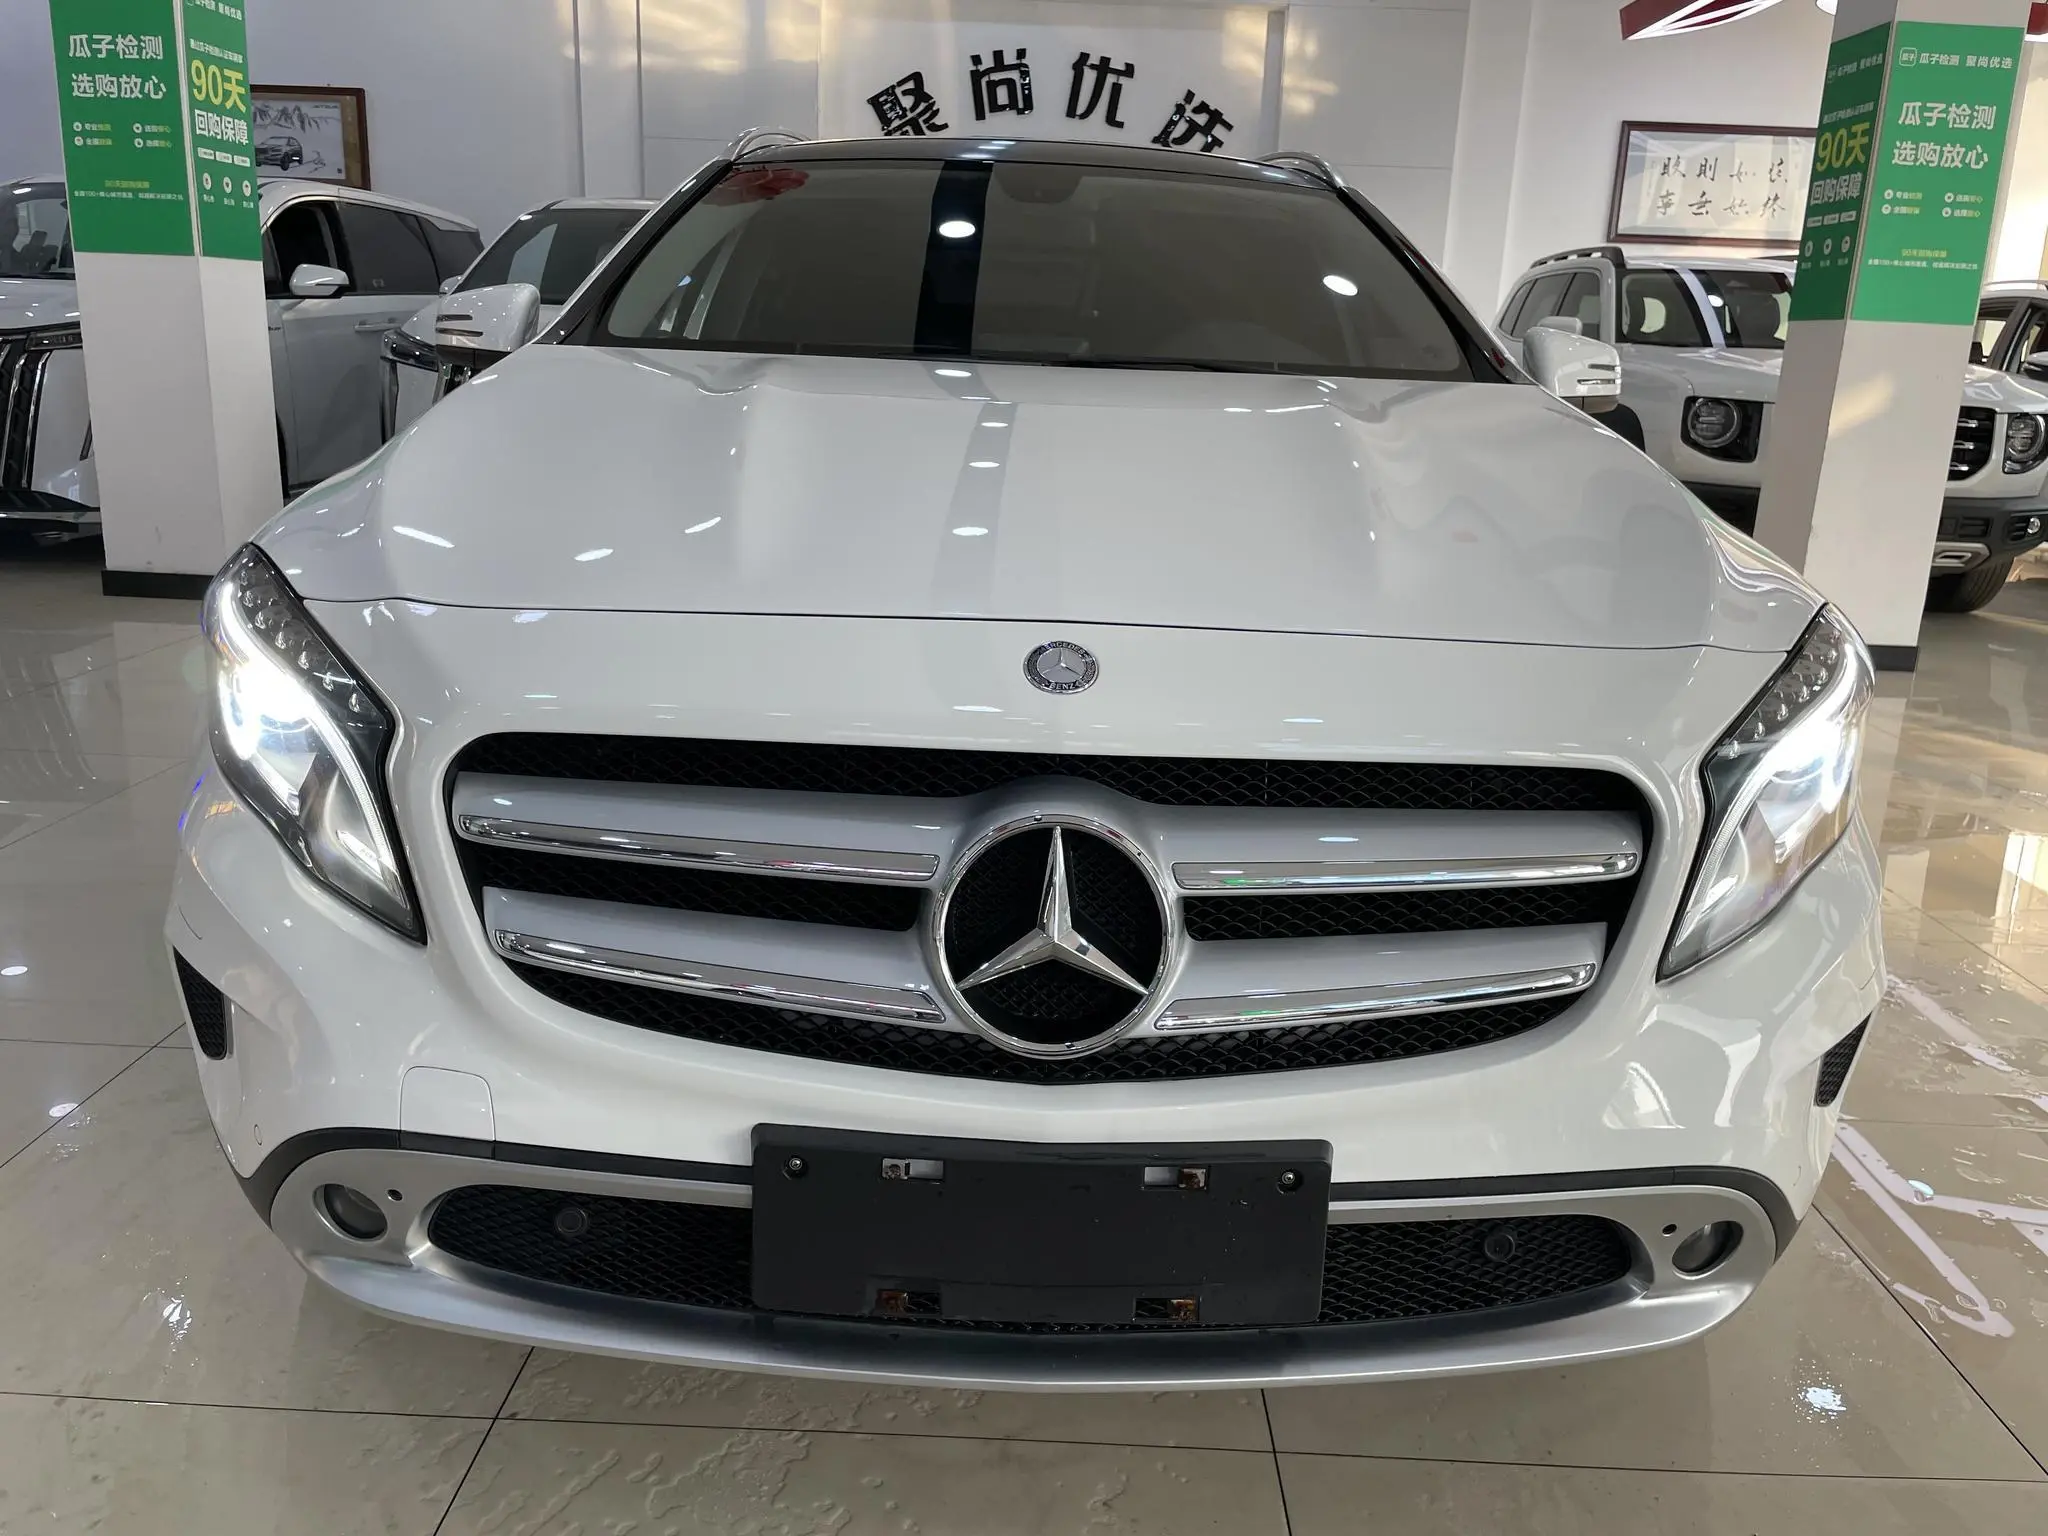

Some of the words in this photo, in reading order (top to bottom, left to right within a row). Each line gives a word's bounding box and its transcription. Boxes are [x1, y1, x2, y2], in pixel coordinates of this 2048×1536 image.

[68, 33, 164, 60] 瓜子检测
[1919, 52, 1960, 66] 瓜子检测
[1965, 54, 2013, 69] 聚尚优选
[71, 72, 167, 100] 选购放心
[191, 58, 247, 115] 90天
[866, 47, 1235, 153] 聚尚优选
[194, 108, 250, 146] 回购保障
[1897, 100, 1997, 132] 瓜子检测
[1815, 120, 1871, 173] 90天
[1891, 140, 1990, 170] 选购放心
[1810, 171, 1864, 206] 回购保障
[1048, 681, 1076, 690] BENZ
